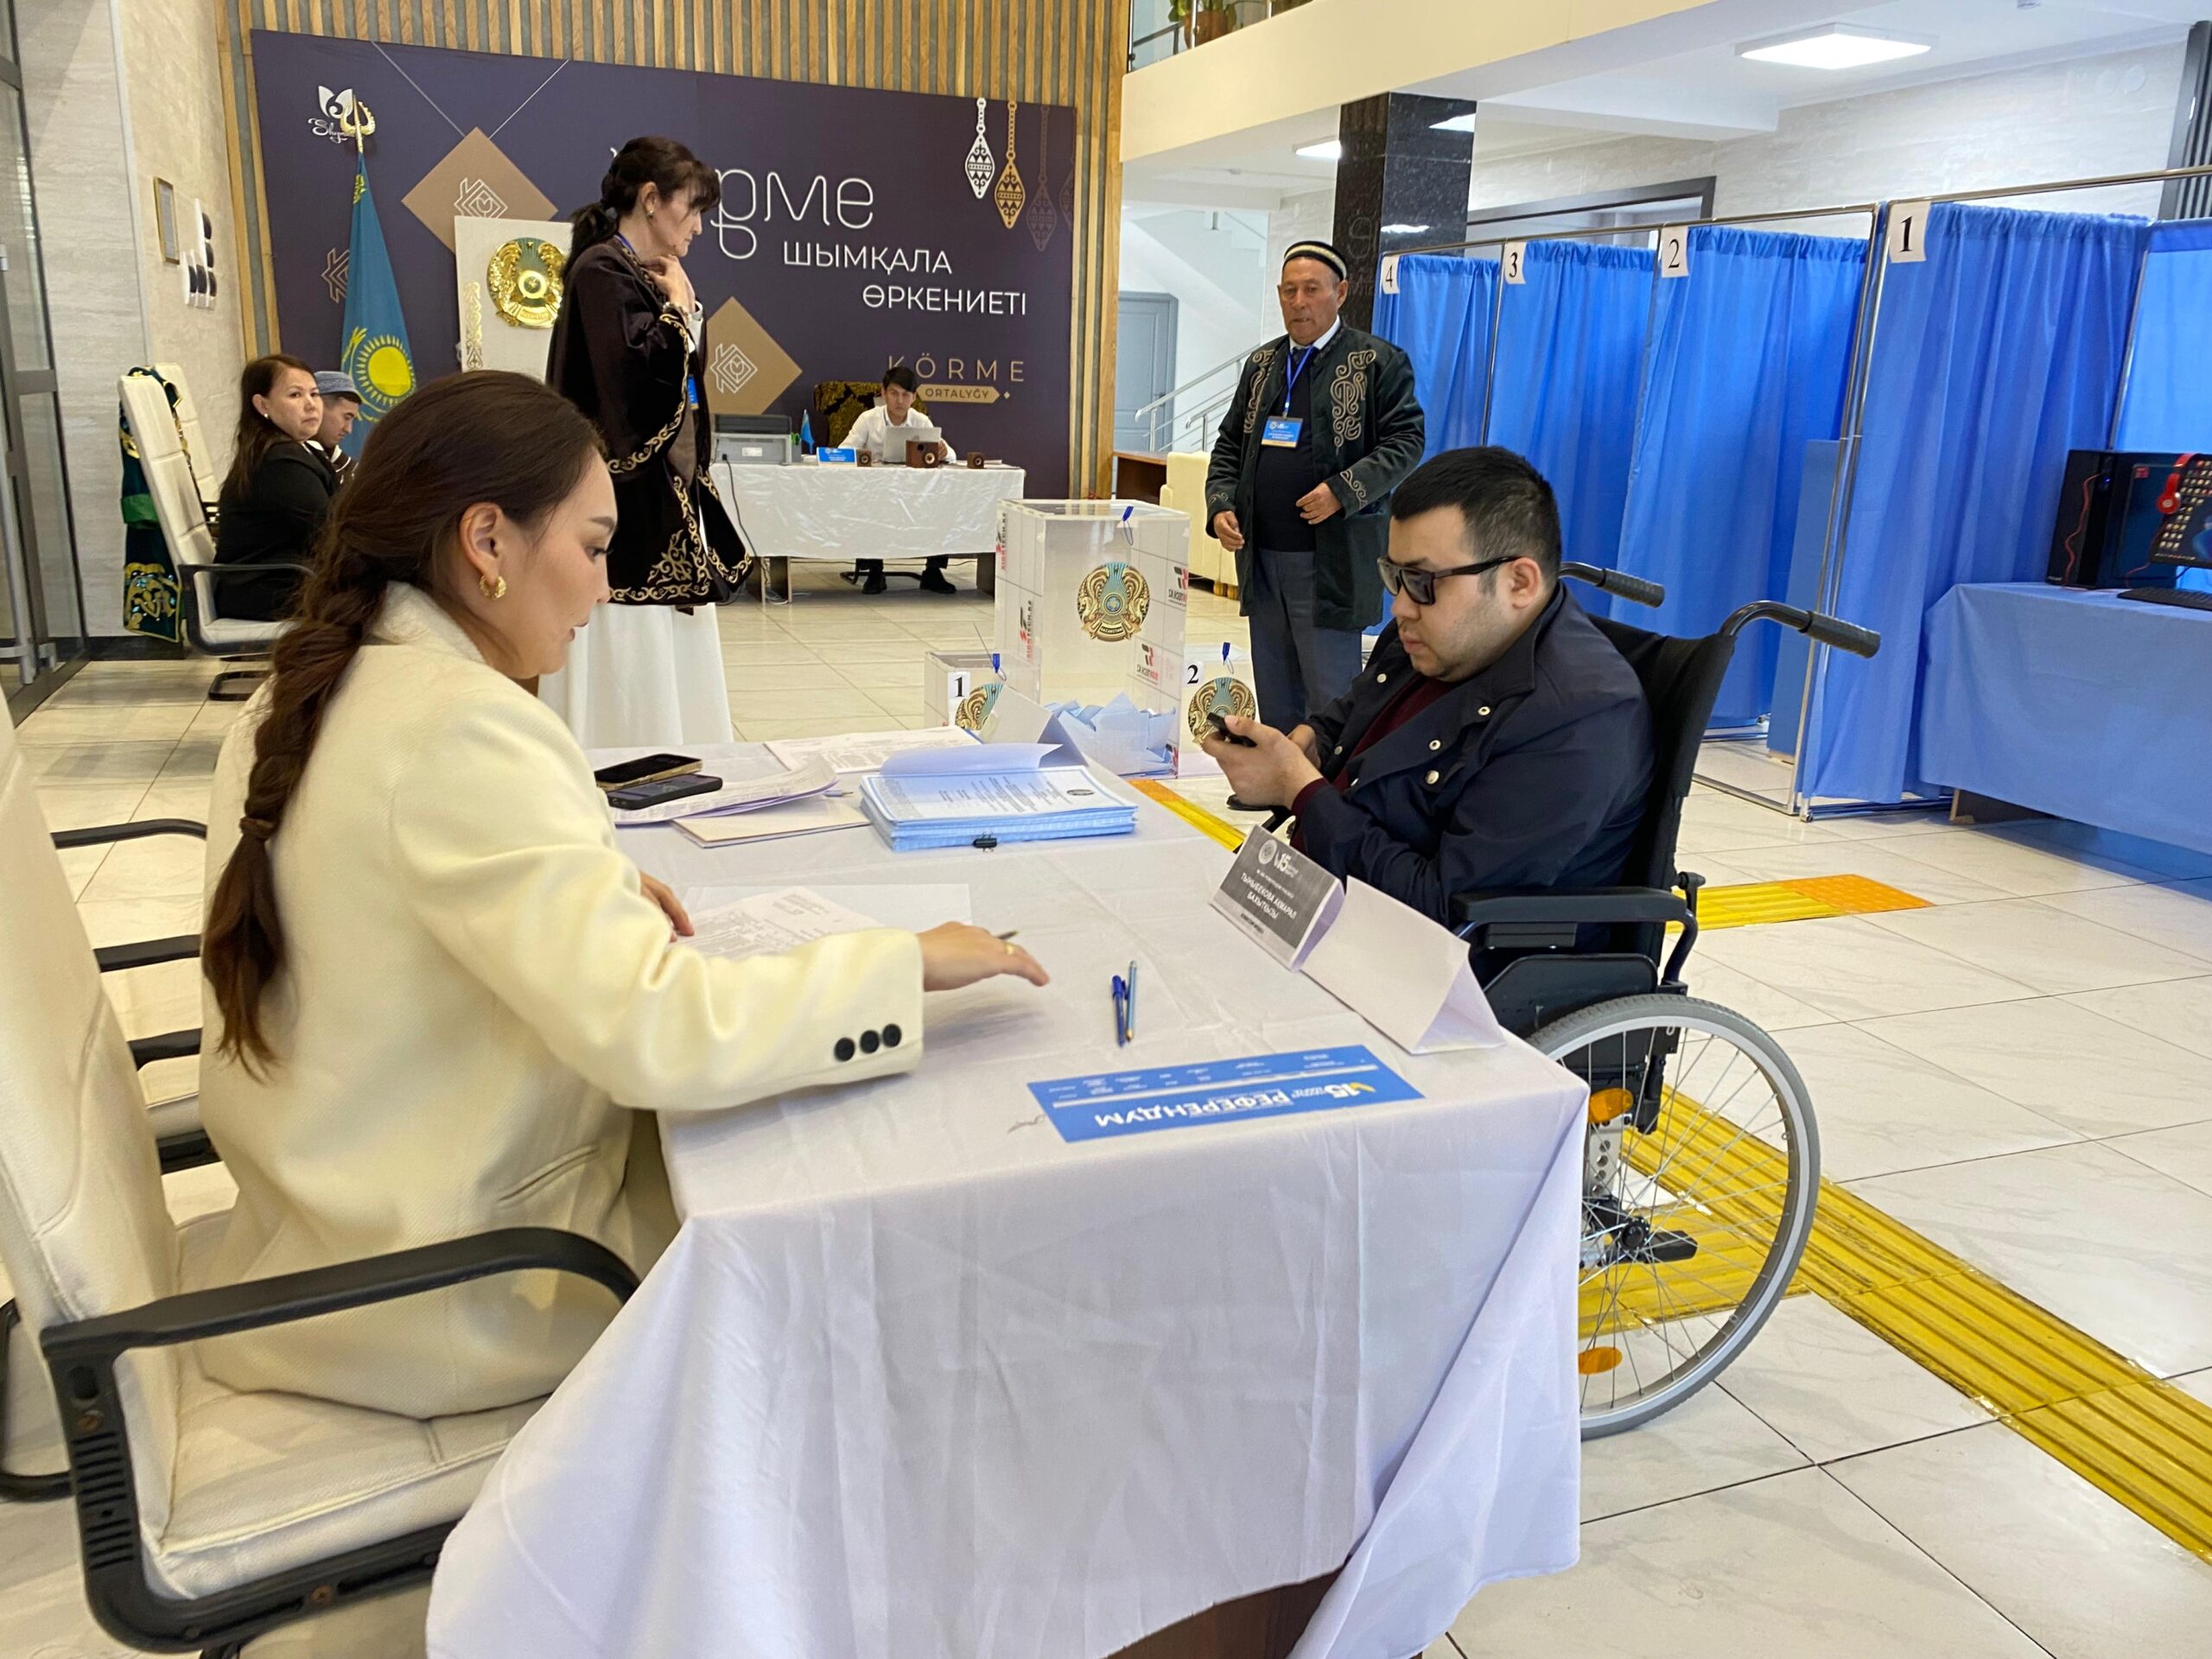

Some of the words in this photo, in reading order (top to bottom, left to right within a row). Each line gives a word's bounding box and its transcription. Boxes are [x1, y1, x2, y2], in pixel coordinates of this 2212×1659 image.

[1900, 216, 1912, 252] 1
[784, 241, 952, 275] ШЫМҚАЛА
[1509, 251, 1518, 278] 3
[1668, 238, 1680, 269] 2
[1385, 264, 1394, 288] 4
[862, 284, 1026, 315] ӨРКЕНИЕТІ
[954, 676, 965, 697] 1
[1186, 664, 1199, 684] 2
[1324, 1083, 1361, 1099] 15
[1094, 1089, 1292, 1128] РЕФЕРЕНДУМ
